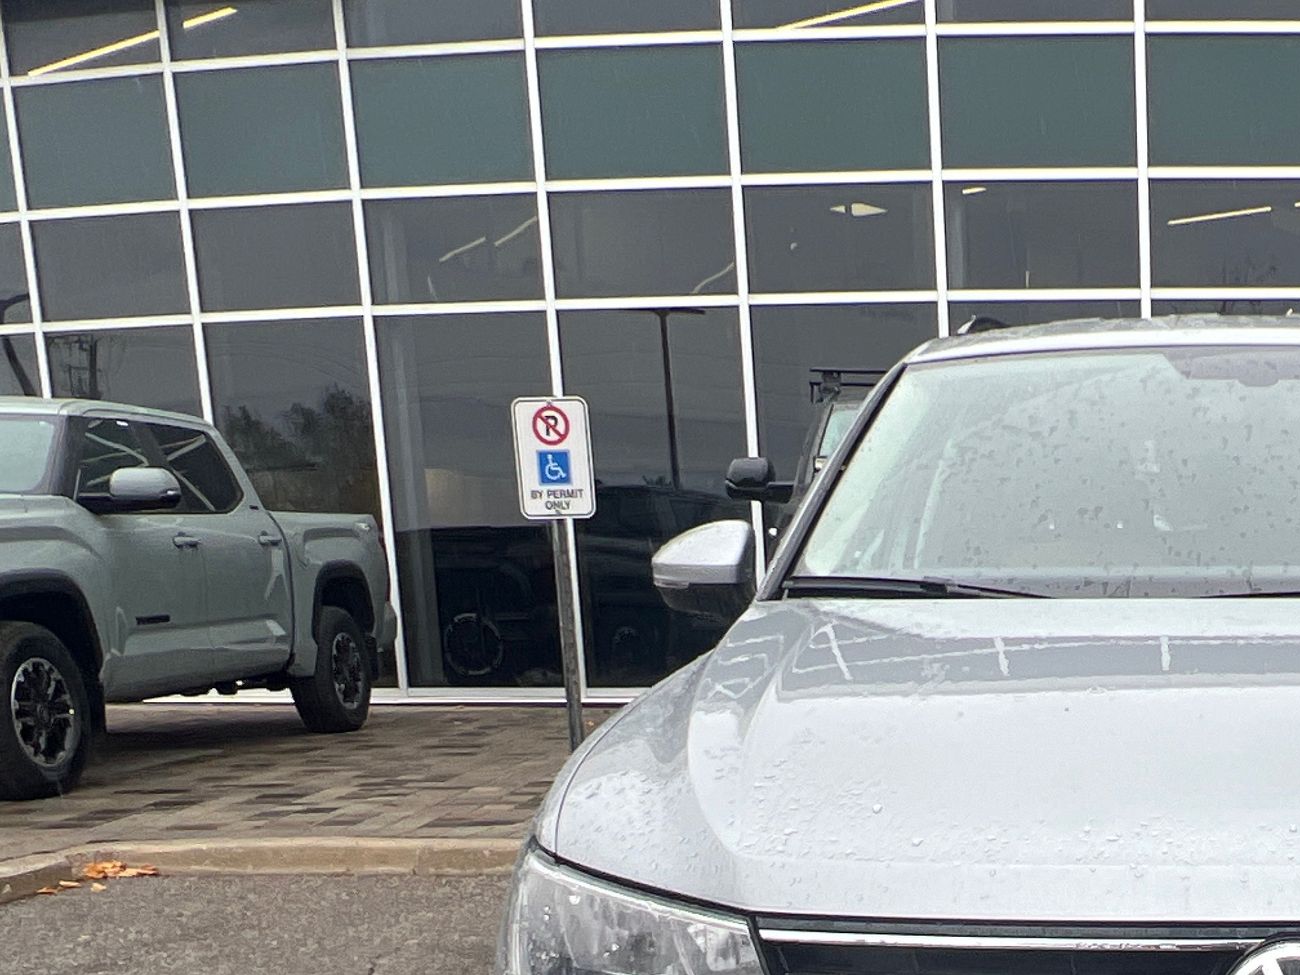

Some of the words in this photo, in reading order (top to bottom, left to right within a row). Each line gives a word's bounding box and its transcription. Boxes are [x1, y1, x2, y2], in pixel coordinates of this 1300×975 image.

[530, 490, 543, 500] BY
[546, 488, 584, 499] PERMIT
[545, 500, 571, 510] ONLY
